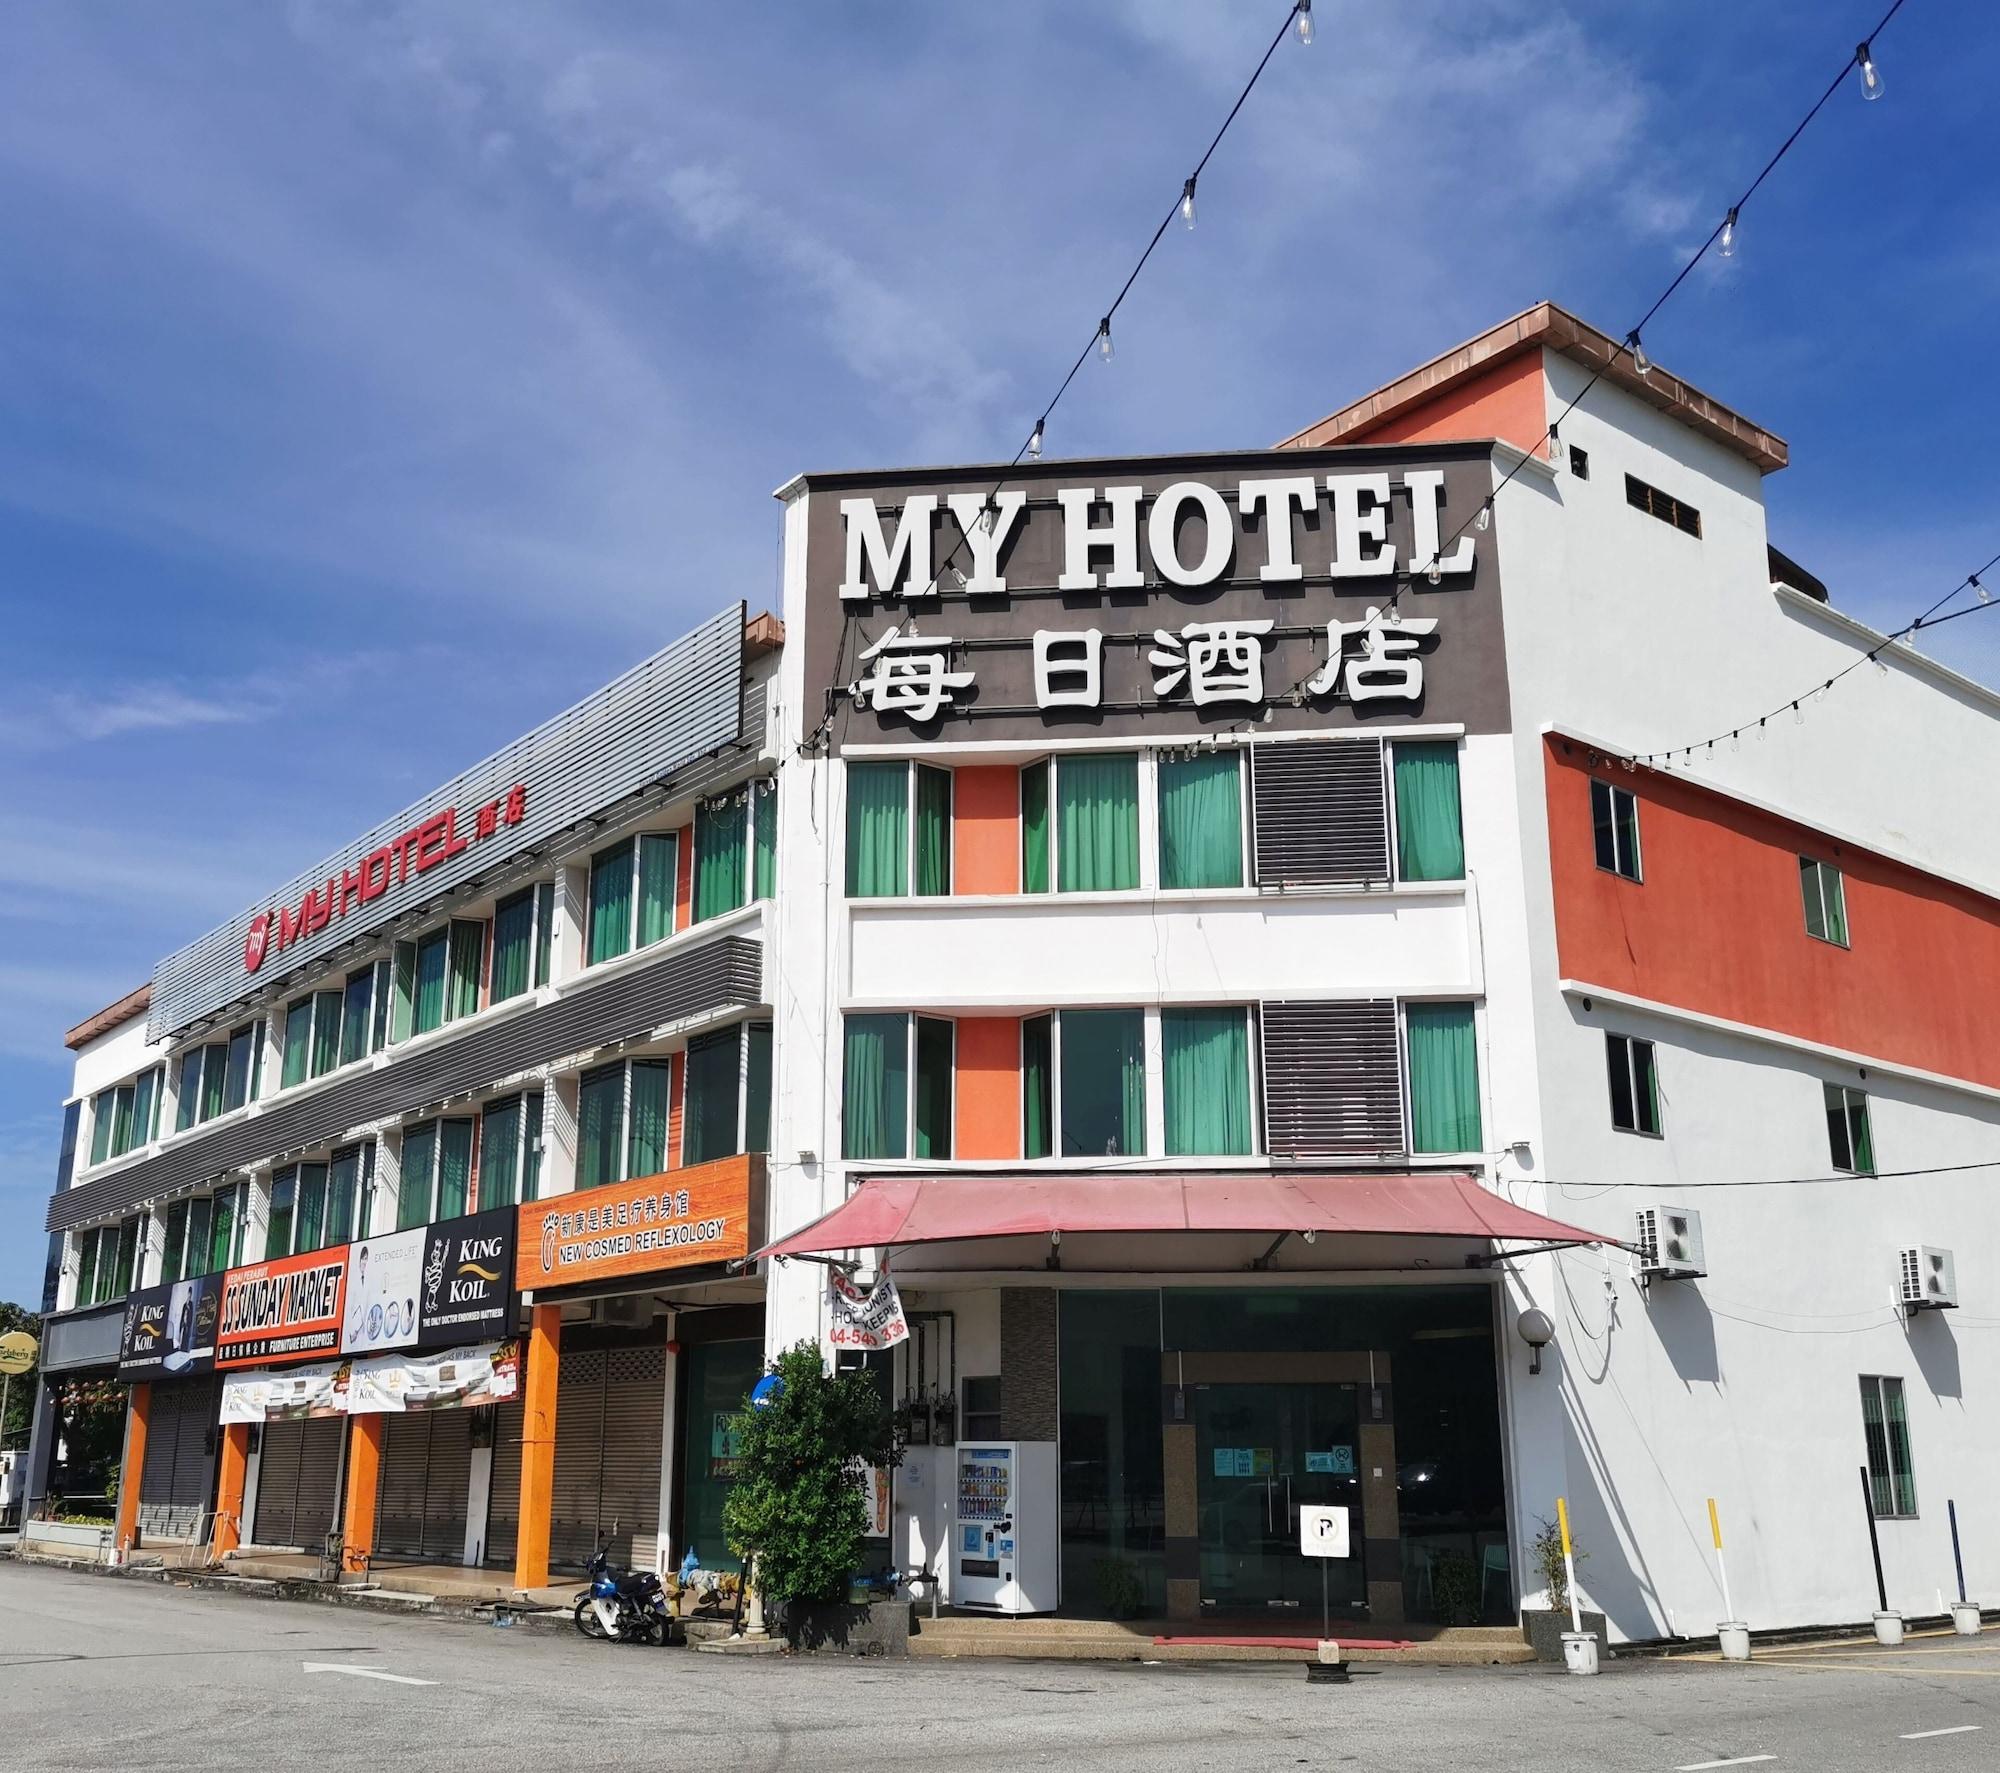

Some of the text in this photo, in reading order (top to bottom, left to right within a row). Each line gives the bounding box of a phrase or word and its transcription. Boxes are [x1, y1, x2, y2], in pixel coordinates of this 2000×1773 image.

[839, 470, 1476, 599] MY HOTEL
[848, 606, 1439, 722] 每日酒店
[277, 879, 335, 951] MY
[339, 808, 468, 916] HOTEL
[458, 1237, 503, 1263] KING
[560, 1219, 726, 1263] NEW COSMED REFLEXOLOGY
[234, 1276, 288, 1331] SUNDAY
[286, 1264, 343, 1323] MARKET
[449, 1280, 487, 1304] KOIL
[140, 1305, 165, 1322] KING
[422, 1318, 431, 1328] THE
[441, 1313, 458, 1325] DOCTOR
[480, 1307, 504, 1320] MATTRESS
[134, 1335, 155, 1352] KOIL
[269, 1332, 335, 1353] FURNITURE ENTERPRISE
